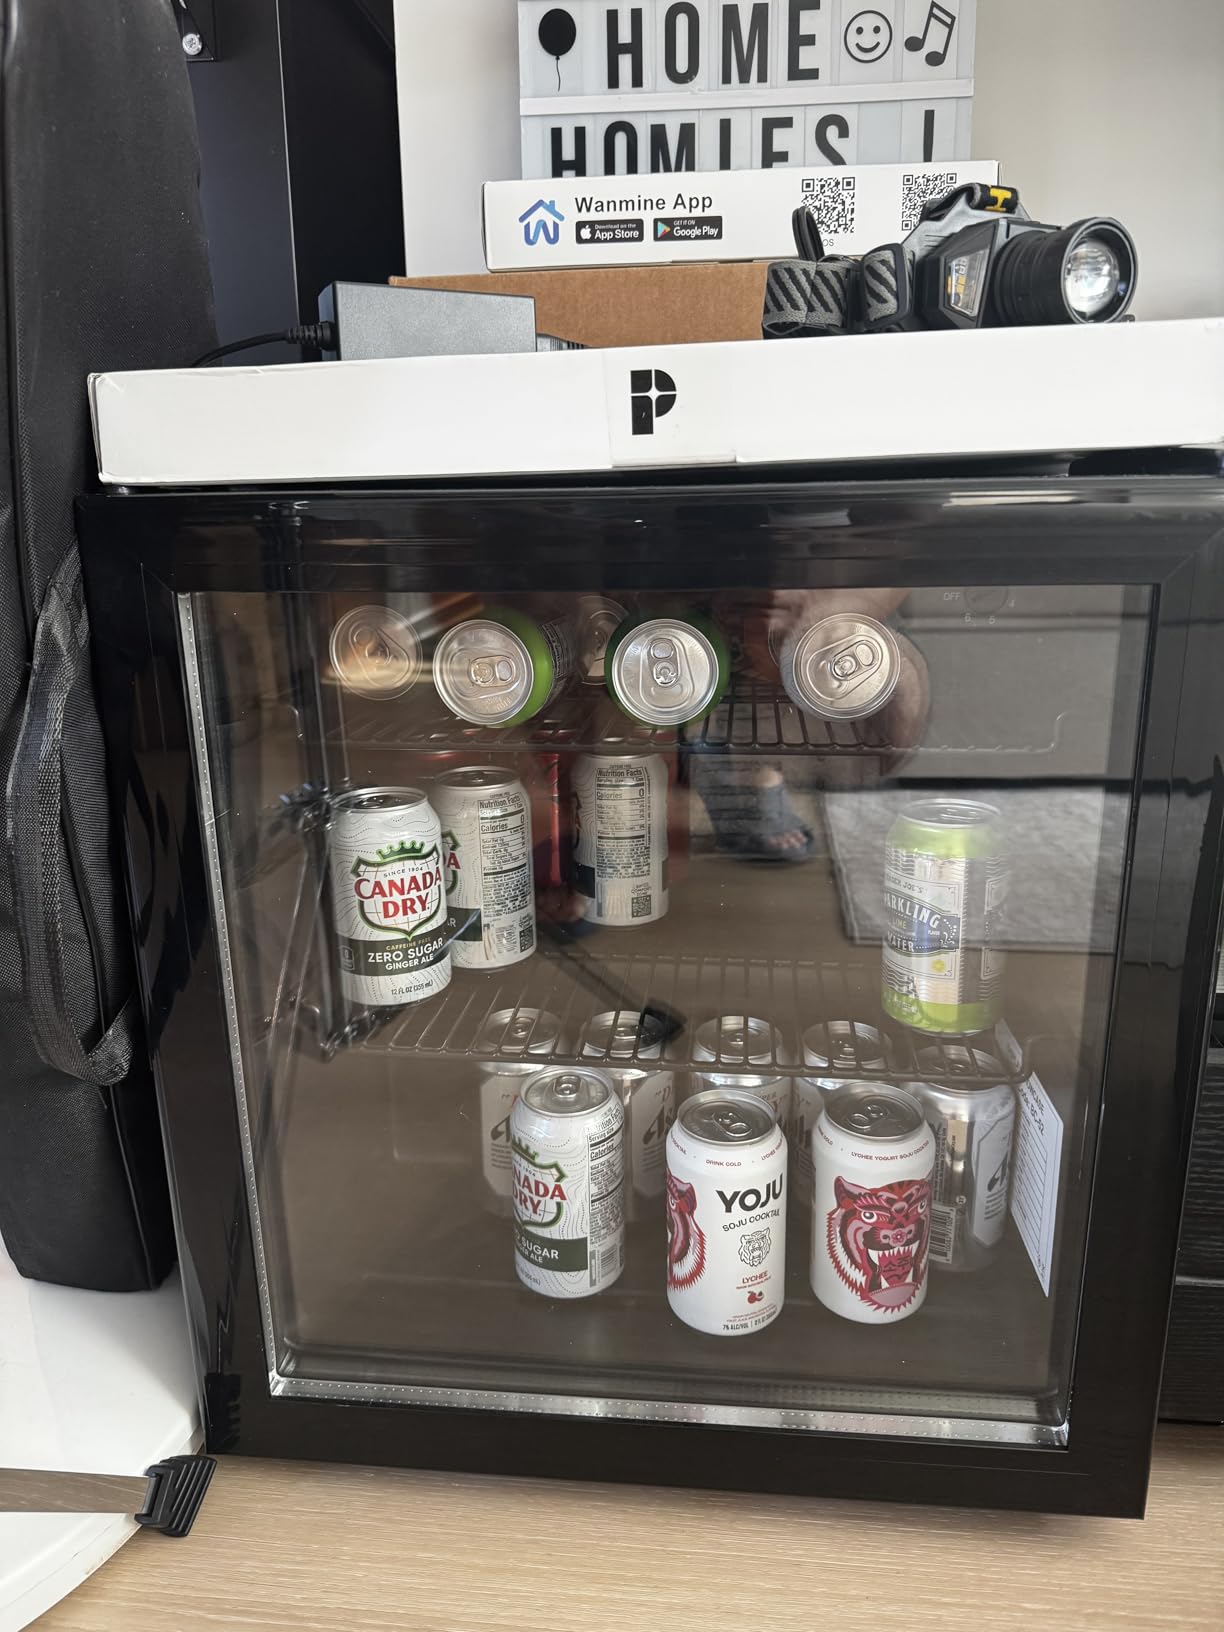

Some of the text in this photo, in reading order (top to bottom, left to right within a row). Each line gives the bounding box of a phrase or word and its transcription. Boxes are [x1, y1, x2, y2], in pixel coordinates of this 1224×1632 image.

[606, 0, 821, 90] HOME
[574, 192, 714, 214] Wanmine App
[594, 228, 640, 241] App Store
[673, 225, 719, 238] Google Play
[626, 768, 642, 777] Facts
[479, 799, 508, 809] Nutrition
[507, 795, 521, 805] Facts
[596, 787, 645, 800] Calories 0
[480, 814, 525, 833] Calories 0
[383, 867, 406, 878] SINCE
[353, 865, 443, 900] CANADA
[381, 892, 430, 919] DRY
[367, 937, 444, 963] ZERO SUGAR
[385, 940, 417, 951] CAFFEINE
[886, 930, 916, 953] WATER
[385, 952, 435, 971] GINGER ALE
[398, 986, 405, 995] FL
[405, 985, 413, 993] OZ
[705, 1158, 725, 1167] DRINK
[851, 1151, 874, 1161] LYCHEE
[899, 1151, 914, 1160] SOJU
[512, 1163, 568, 1201] NADA
[715, 1172, 784, 1214] YOJU
[722, 1207, 780, 1233] SOJU COCKTAIL
[521, 1235, 560, 1260] SUGAR
[530, 1252, 544, 1264] ALE
[741, 1269, 769, 1285] LYCHEE
